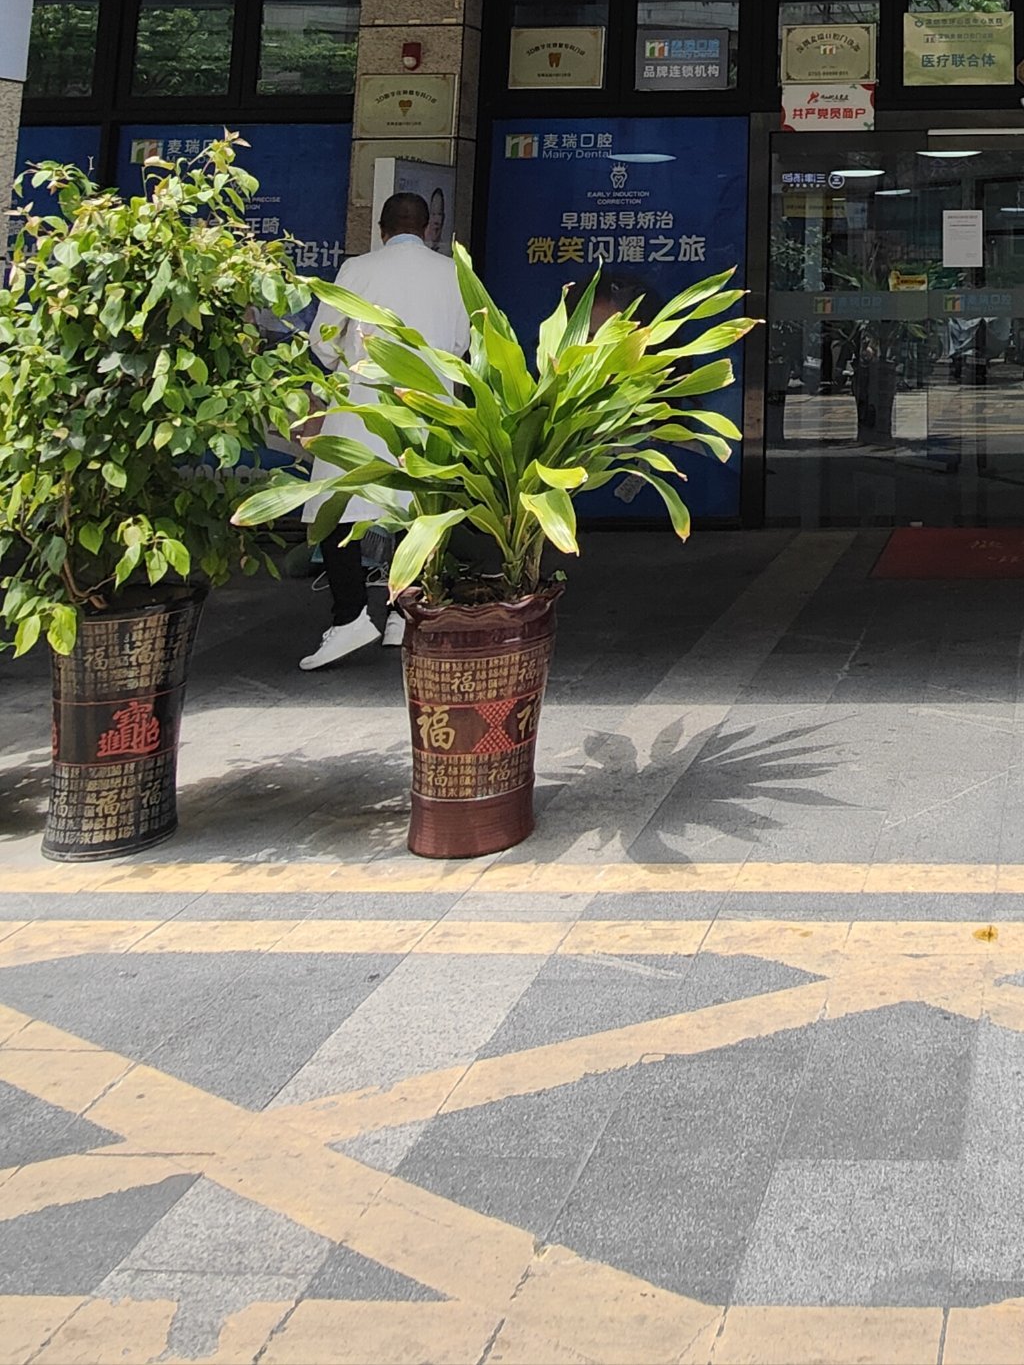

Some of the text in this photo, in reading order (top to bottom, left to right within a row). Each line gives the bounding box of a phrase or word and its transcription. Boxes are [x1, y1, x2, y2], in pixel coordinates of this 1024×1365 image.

[922, 53, 995, 68] 医疗联合体
[643, 65, 720, 78] 品牌连锁机构
[792, 108, 866, 120] 共产党员商户
[543, 133, 613, 149] 麦瑞口腔
[542, 149, 613, 161] Mairy Dental
[561, 211, 675, 231] 早期诱导矫治
[527, 235, 707, 264] 微笑闪耀之旅
[451, 671, 478, 694] 福
[417, 704, 457, 751] 福
